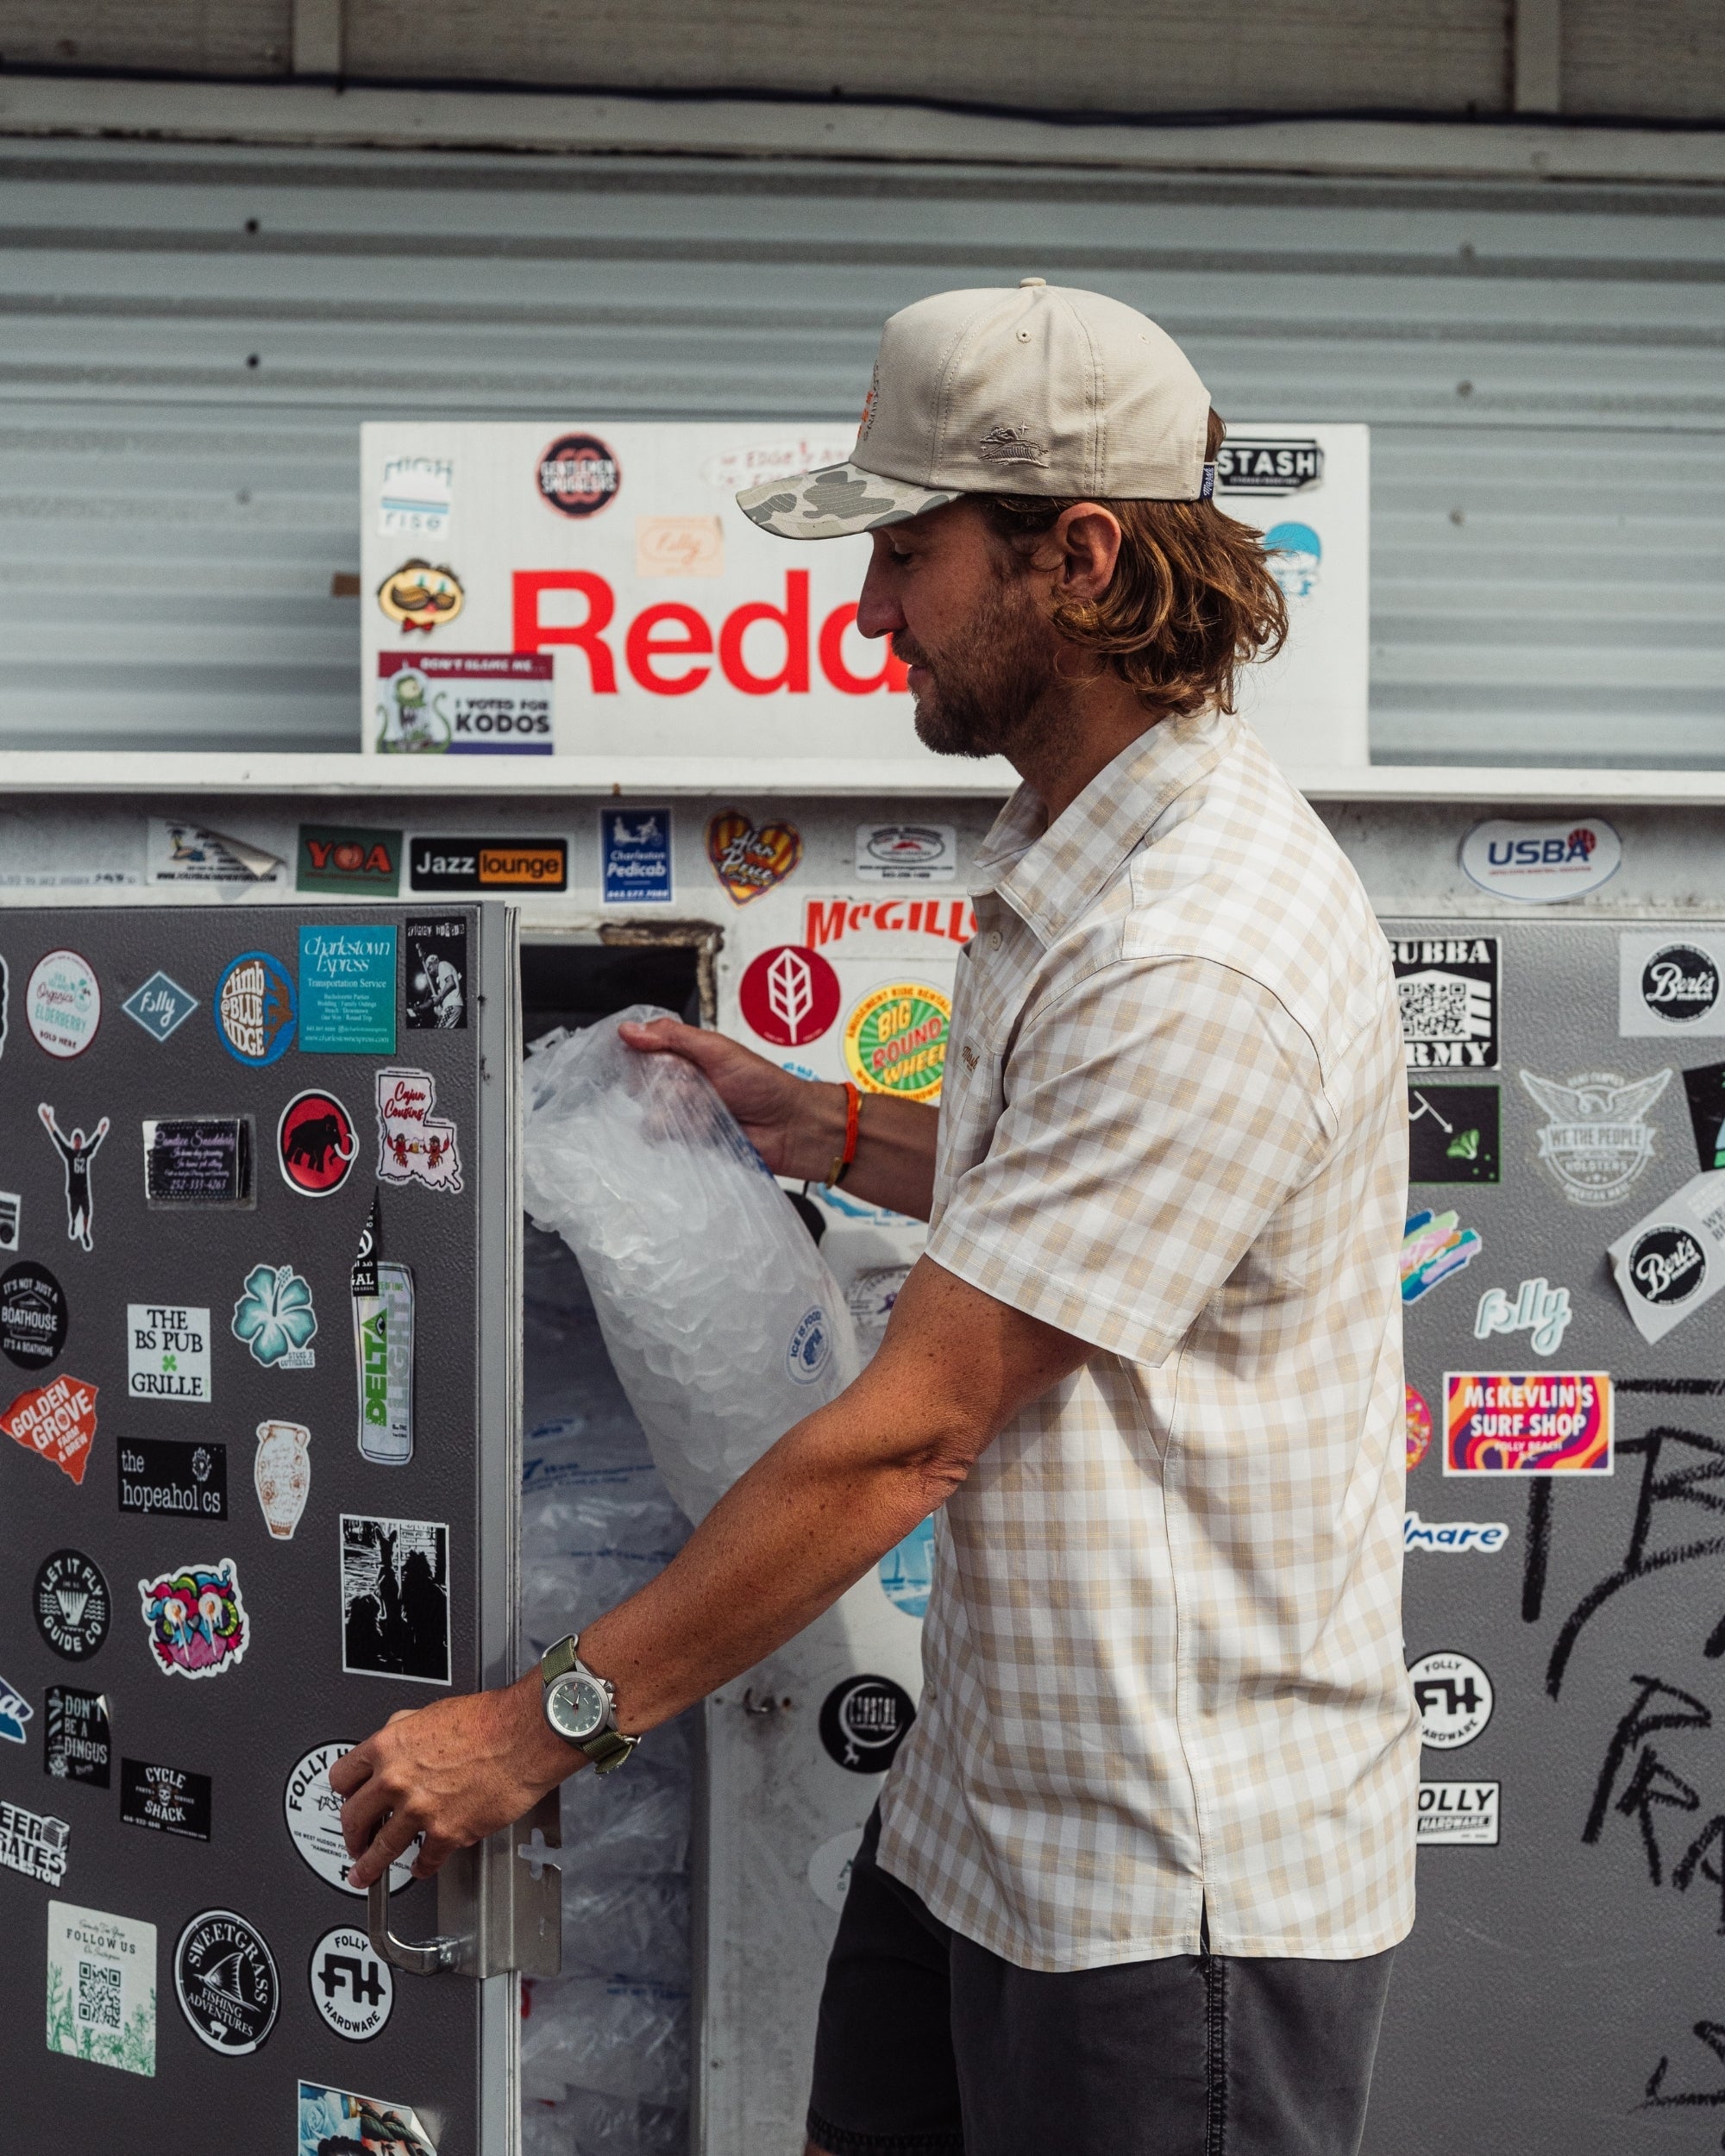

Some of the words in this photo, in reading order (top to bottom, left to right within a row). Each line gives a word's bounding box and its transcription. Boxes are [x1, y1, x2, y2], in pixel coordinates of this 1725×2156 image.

[1216, 449, 1315, 476] STASH
[419, 656, 462, 671] DON'T
[464, 658, 509, 672] BLAME
[455, 698, 461, 709] I
[467, 698, 515, 710] VOTED
[520, 699, 549, 711] FOR
[455, 712, 550, 734] KODOS
[609, 849, 666, 862] Charleston
[1488, 837, 1590, 866] USBA
[416, 851, 475, 874] Jazz
[481, 852, 559, 879] lounge
[606, 862, 666, 878] Pedicab
[804, 899, 978, 950] McGILL
[304, 935, 391, 956] Charlestown
[317, 952, 370, 978] Express
[222, 960, 265, 999] Climb
[308, 978, 359, 989] Transportation
[360, 978, 387, 988] Service
[1645, 962, 1716, 1002] Bert's
[36, 981, 74, 1006] Organics
[35, 1003, 86, 1033] ELDERBERRY
[140, 991, 176, 1027] Folly
[878, 999, 912, 1043] BIG
[40, 1029, 57, 1043] SOLD
[59, 1036, 77, 1049] HERE
[222, 1014, 265, 1056] RIDGE
[873, 1017, 943, 1071] ROUND
[1405, 1041, 1492, 1068] RMY
[394, 1081, 426, 1106] Cajun
[384, 1098, 424, 1121] Cousins
[1597, 1128, 1641, 1146] PEOPLE
[1635, 1236, 1696, 1300] Bert's
[18, 1277, 33, 1290] NOT
[34, 1280, 52, 1298] JUST
[52, 1292, 58, 1303] A
[1, 1305, 58, 1332] BOATHOUSE
[147, 1308, 188, 1331] THE
[1476, 1279, 1571, 1355] Folly
[16, 1340, 22, 1351] A
[135, 1329, 157, 1350] BS
[162, 1332, 204, 1353] PUB
[790, 1336, 801, 1357] ICE
[361, 1307, 387, 1428] DELTA
[131, 1372, 204, 1397] GRILLE
[1464, 1384, 1595, 1408] McKEVLIN'S
[10, 1380, 70, 1439] GOLDEN
[31, 1388, 92, 1451] GROVE
[56, 1425, 79, 1449] FARM
[1470, 1413, 1525, 1438] SURF
[1528, 1413, 1587, 1438] SHOP
[58, 1451, 66, 1463] &
[64, 1432, 89, 1457] BREW
[1494, 1441, 1526, 1452] FOLLY
[1527, 1441, 1563, 1452] BEACH
[122, 1450, 145, 1473] the
[41, 1559, 63, 1592] LET
[67, 1557, 80, 1575] IT
[82, 1566, 104, 1596] FLY
[43, 1615, 83, 1653] GUIDE
[85, 1621, 102, 1645] CO
[1424, 1659, 1463, 1674] FOLLY
[65, 1695, 102, 1722] DON'T
[1414, 1677, 1484, 1718] FH
[64, 1716, 77, 1735] BE
[81, 1720, 88, 1738] A
[1423, 1718, 1478, 1742] ARDWARE
[64, 1735, 108, 1764] DINGUS
[145, 1766, 186, 1789] CYCLE
[289, 1751, 329, 1812] FOLLY
[144, 1800, 186, 1822] SHACK
[1418, 1789, 1495, 1811] OLLY
[0, 1805, 43, 1842] EER
[316, 1837, 336, 1848] HUDSON
[0, 1851, 61, 1888] RLESTON
[390, 1861, 411, 1871] AROLIN
[66, 1927, 116, 1949] FOLLOW
[120, 1940, 136, 1955] US
[335, 1935, 368, 1952] FOLLY
[188, 1923, 268, 2004] SWEETGRASS
[317, 1952, 386, 2007] FH
[187, 1992, 254, 2037] ADVENTURES
[202, 1986, 242, 2019] FISHING
[323, 2001, 381, 2033] HARDWARE
